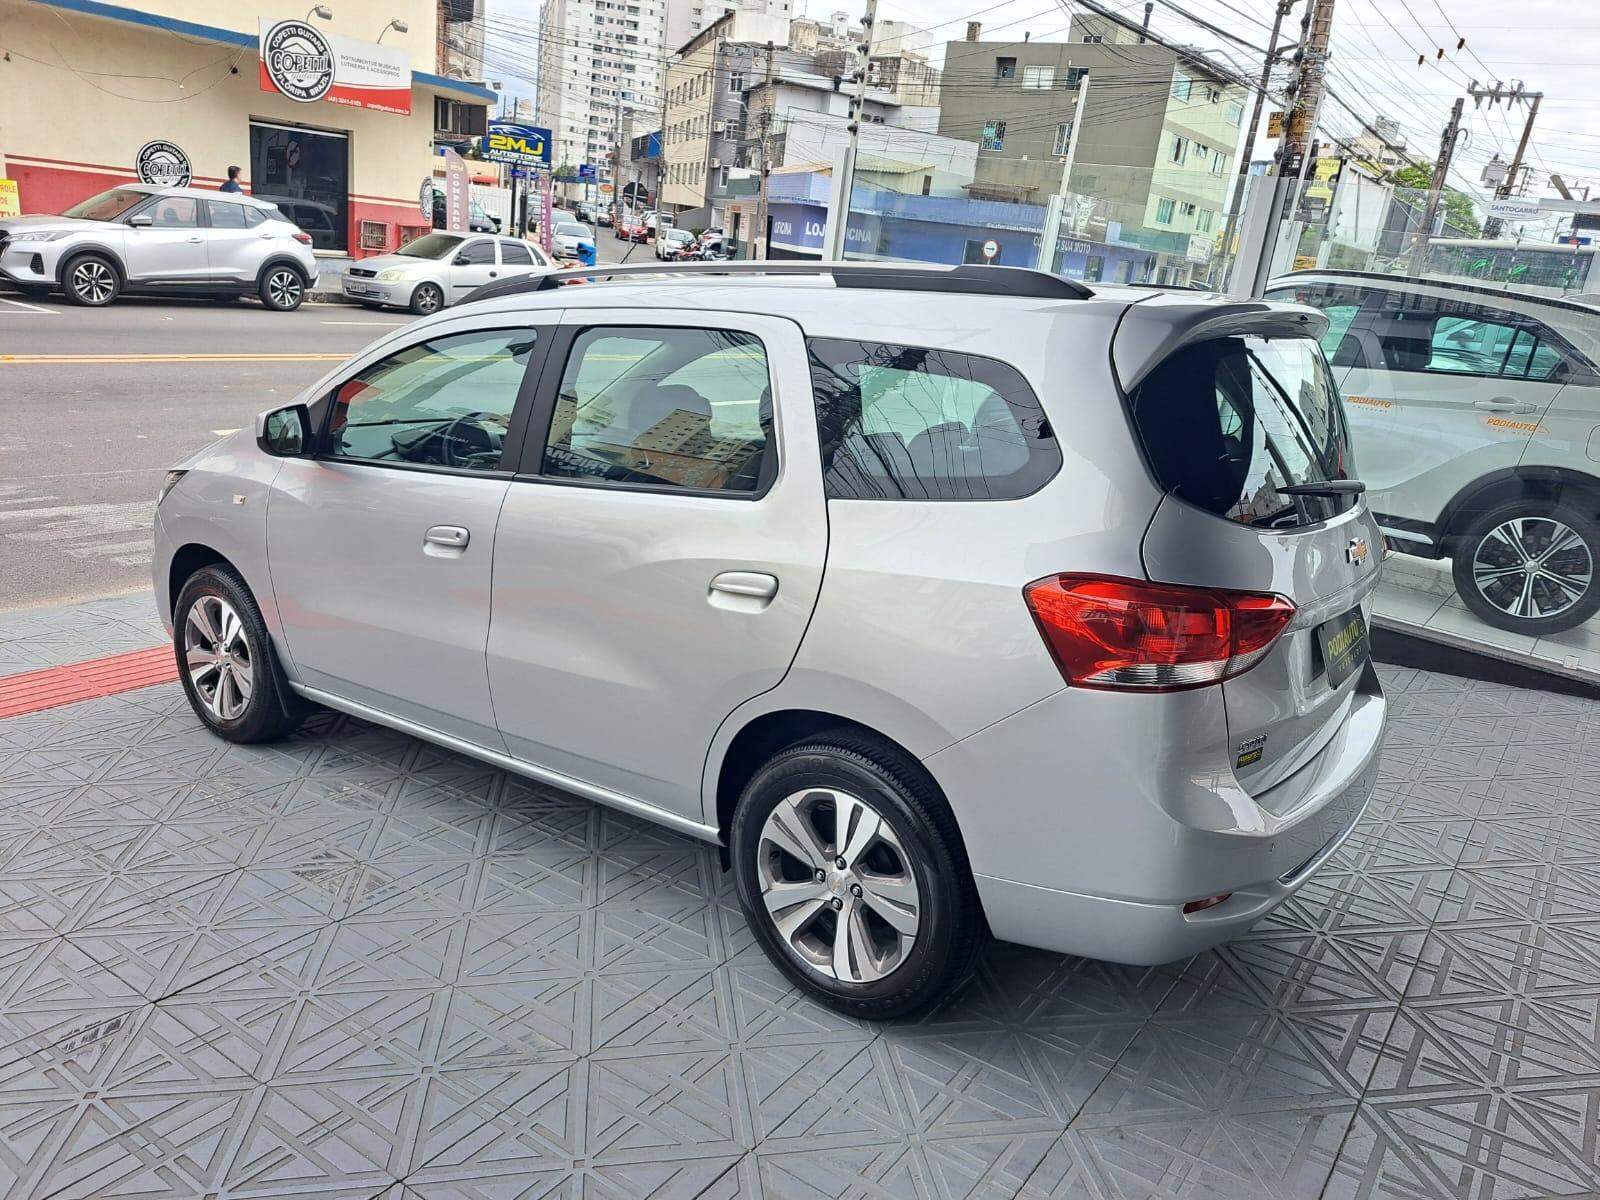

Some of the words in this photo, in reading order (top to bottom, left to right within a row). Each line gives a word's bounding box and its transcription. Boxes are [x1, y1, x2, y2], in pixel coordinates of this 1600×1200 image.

[272, 27, 297, 47] COPETTI
[297, 28, 325, 52] GUITARS
[270, 49, 329, 74] COPETTI
[309, 76, 329, 96] BRAZIL
[489, 134, 543, 156] 2MJ
[489, 149, 543, 162] AUTOSTORE
[1491, 204, 1539, 215] SANTOCARRO
[774, 221, 792, 236] OFICINA
[805, 221, 827, 237] LOJ
[1060, 240, 1073, 251] SUA
[1074, 242, 1091, 254] MOTO
[1347, 395, 1392, 409] PODIAUTO
[1487, 417, 1537, 432] PODIAUTO
[1327, 620, 1359, 661] PODIAUTO
